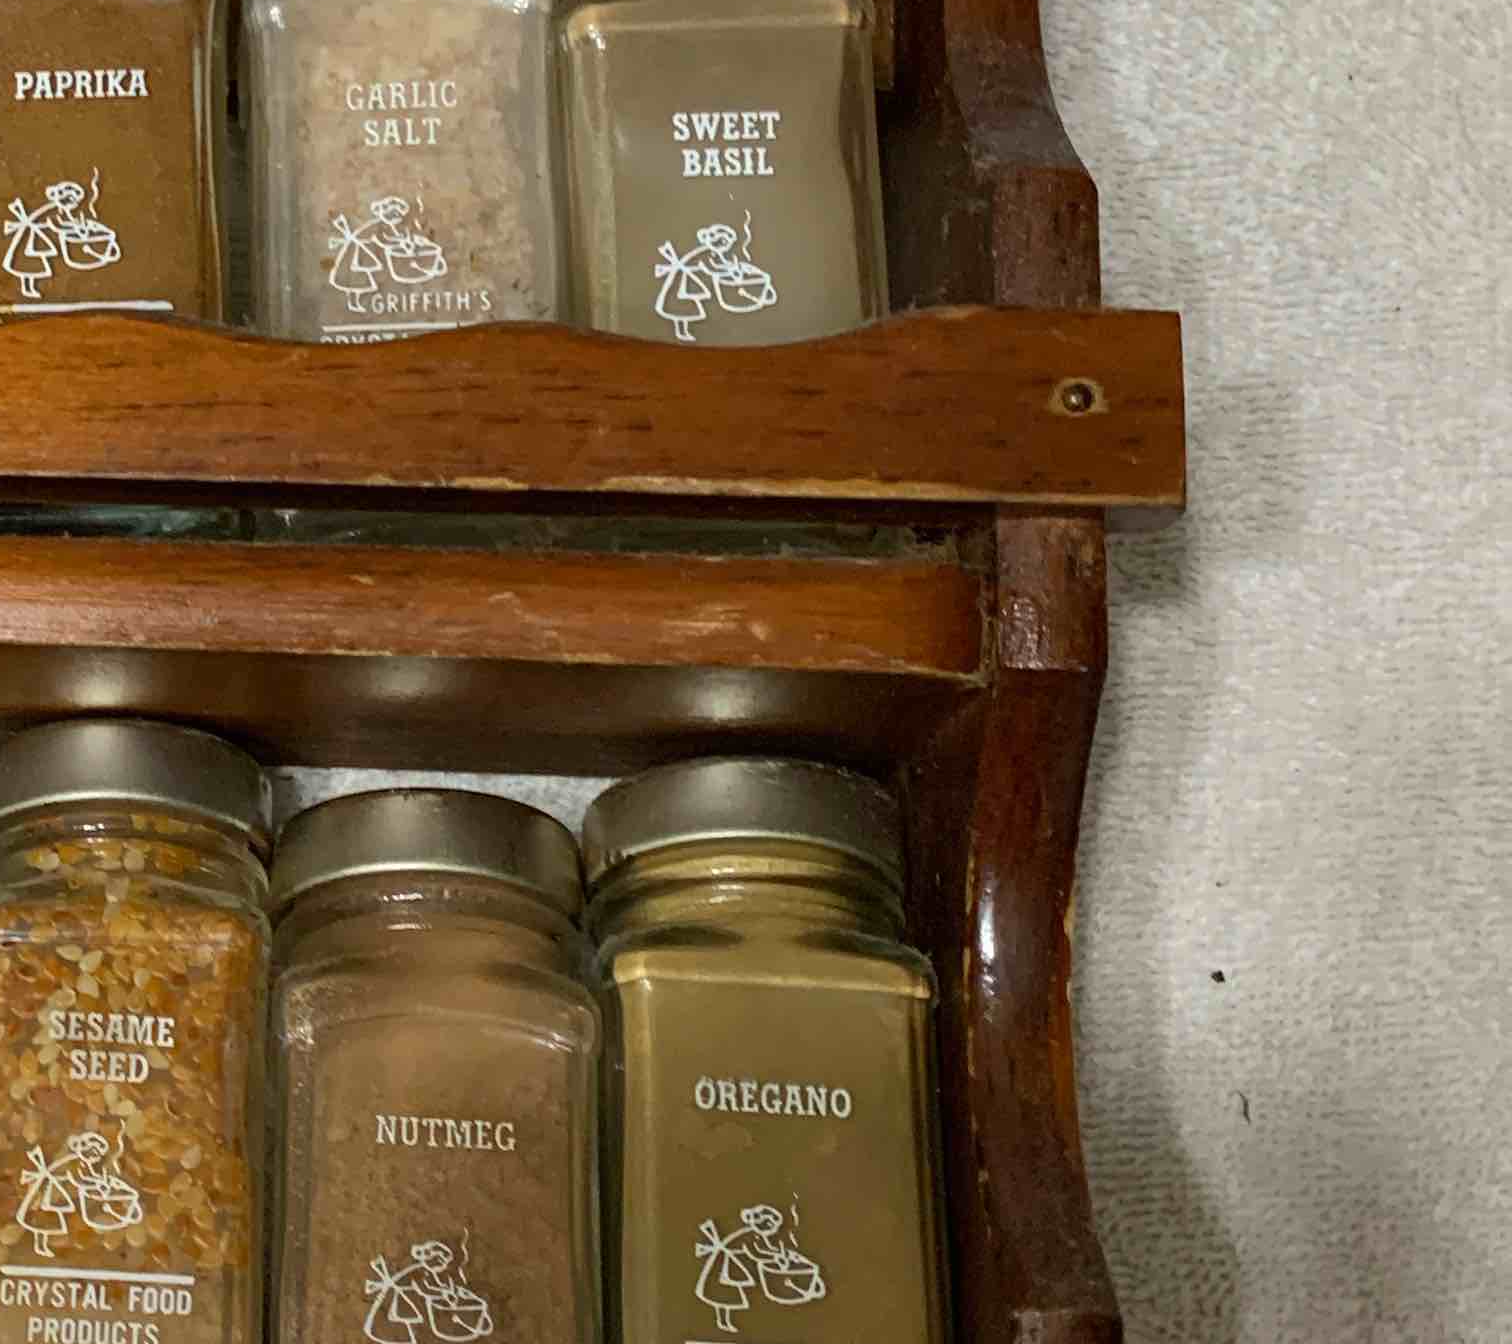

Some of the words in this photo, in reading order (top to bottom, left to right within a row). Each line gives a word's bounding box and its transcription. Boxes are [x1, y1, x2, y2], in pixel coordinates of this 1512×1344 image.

[14, 68, 149, 101] PAPRIKA
[345, 80, 457, 111] GARLIC
[364, 116, 442, 147] SALT
[672, 111, 781, 142] SWEET
[681, 146, 774, 177] BASIL
[370, 290, 492, 314] GRIFFITH'S
[48, 1010, 176, 1048] SESAME
[70, 1048, 150, 1084] SEED
[694, 1076, 853, 1118] OREGANO
[375, 1114, 517, 1152] NUTMEG
[0, 1278, 113, 1312] CRYSTAL
[128, 1285, 193, 1316] FOOD
